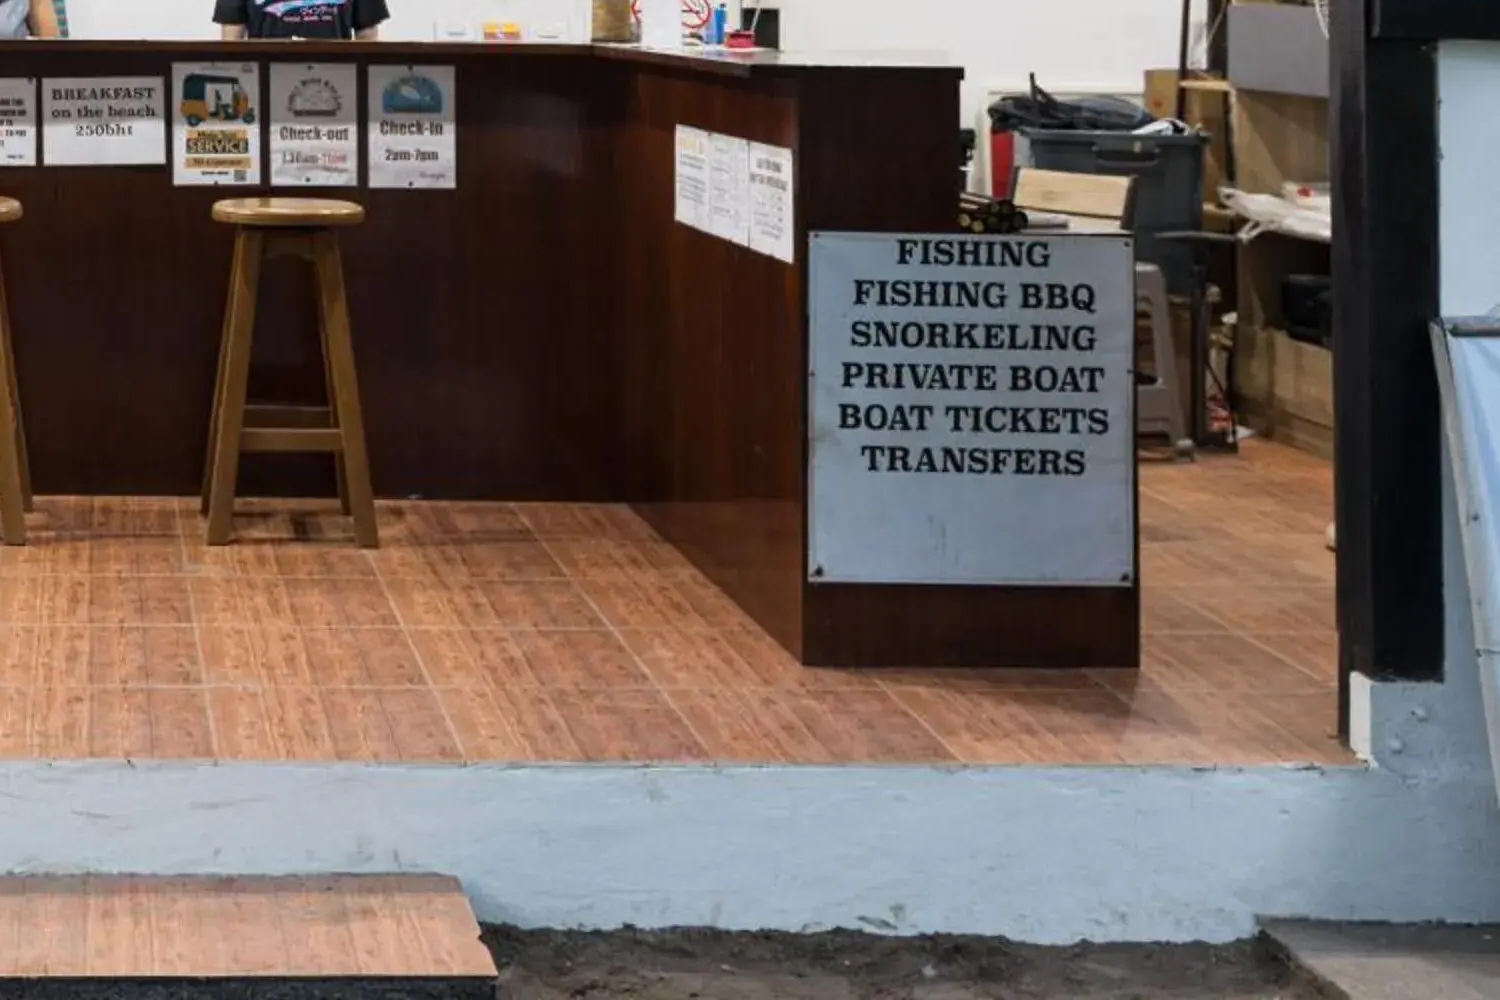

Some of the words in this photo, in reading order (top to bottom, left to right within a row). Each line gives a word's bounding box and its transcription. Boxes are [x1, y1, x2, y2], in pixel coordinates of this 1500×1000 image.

[51, 87, 155, 101] BREAKFAST
[77, 104, 103, 118] the
[108, 104, 156, 118] beach
[280, 126, 349, 141] Check-out
[896, 239, 1052, 267] FISHING
[853, 279, 1008, 308] FISHING
[1020, 283, 1097, 313] BBQ
[850, 321, 1097, 351] SNORKELING
[841, 361, 997, 391] PRIVATE
[1009, 365, 1106, 393] BOAT
[838, 403, 934, 432] BOAT
[945, 405, 1110, 435] TICKETS
[860, 445, 1087, 476] TRANSFERS
